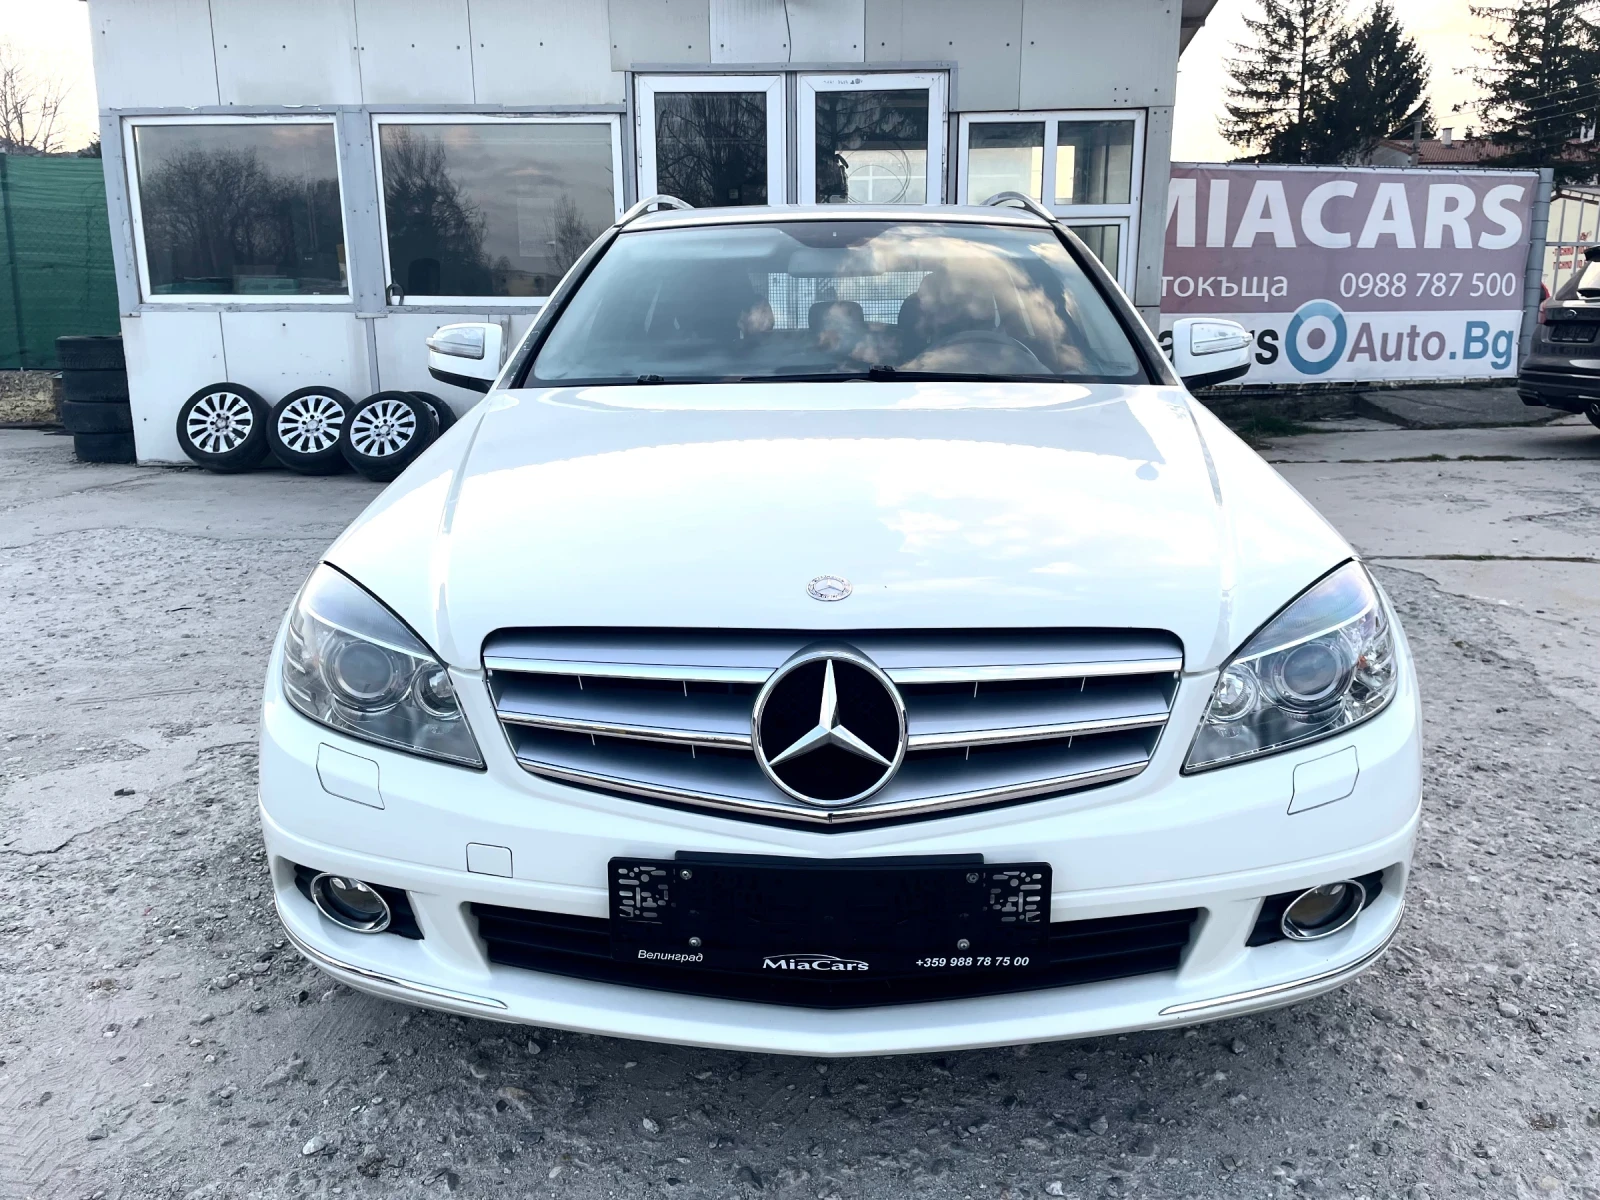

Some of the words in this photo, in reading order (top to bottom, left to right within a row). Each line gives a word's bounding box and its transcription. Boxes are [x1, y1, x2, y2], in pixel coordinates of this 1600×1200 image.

[1339, 272, 1407, 298] 0988
[1415, 272, 1464, 297] 787
[1469, 272, 1517, 297] 500
[637, 949, 704, 964] Велинград
[915, 957, 947, 968] +359
[949, 956, 973, 967] 988
[976, 956, 992, 967] 78
[995, 956, 1011, 967] 75
[1013, 956, 1030, 967] 00
[762, 958, 870, 971] MiaCars
